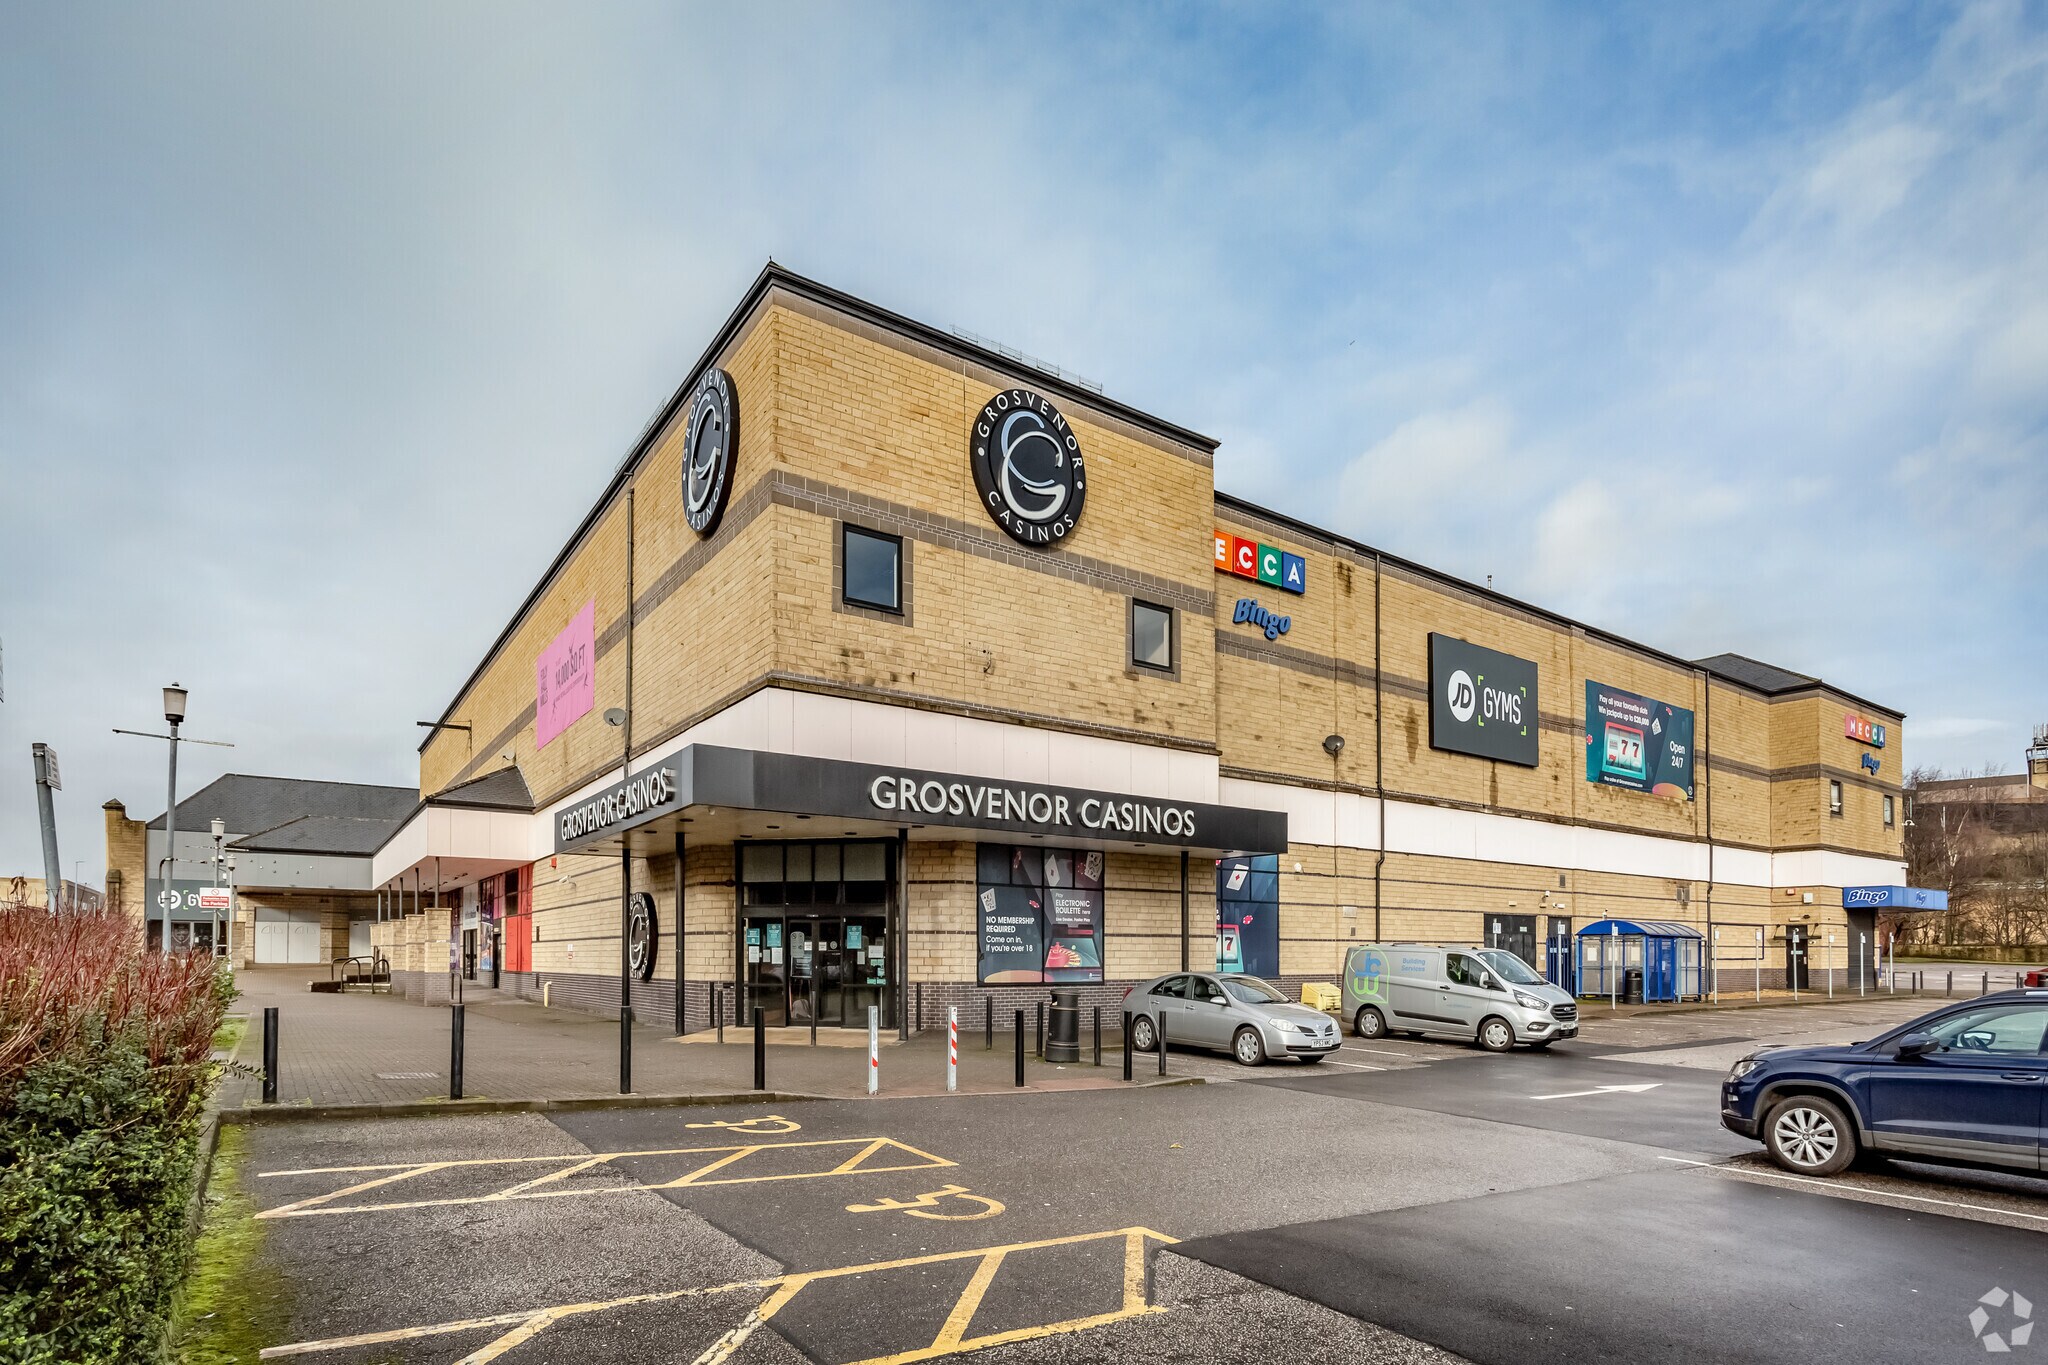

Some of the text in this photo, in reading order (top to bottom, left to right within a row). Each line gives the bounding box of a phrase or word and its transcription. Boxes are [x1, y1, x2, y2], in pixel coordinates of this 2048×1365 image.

[683, 370, 729, 461] GROSVENOR
[977, 390, 1083, 471] GROSVENOR
[686, 470, 724, 530] CASINOS
[988, 491, 1074, 541] CASINOS
[1215, 537, 1301, 584] ECCA
[1233, 598, 1291, 640] Bingo
[1452, 683, 1521, 724] JD GYMS
[1598, 705, 1606, 714] Win
[1599, 694, 1608, 705] Play
[1614, 700, 1622, 708] your
[1670, 740, 1686, 754] Open
[1850, 720, 1884, 743] MECCA
[1672, 756, 1684, 768] 24/7
[561, 767, 667, 841] GROSVENOR CASINOS
[869, 775, 1195, 838] GROSVENOR CASINOS
[1848, 889, 1888, 904] Bingo
[998, 917, 1034, 925] MEMBERSHIP
[990, 945, 1009, 953] you're
[1402, 958, 1426, 966] Building
